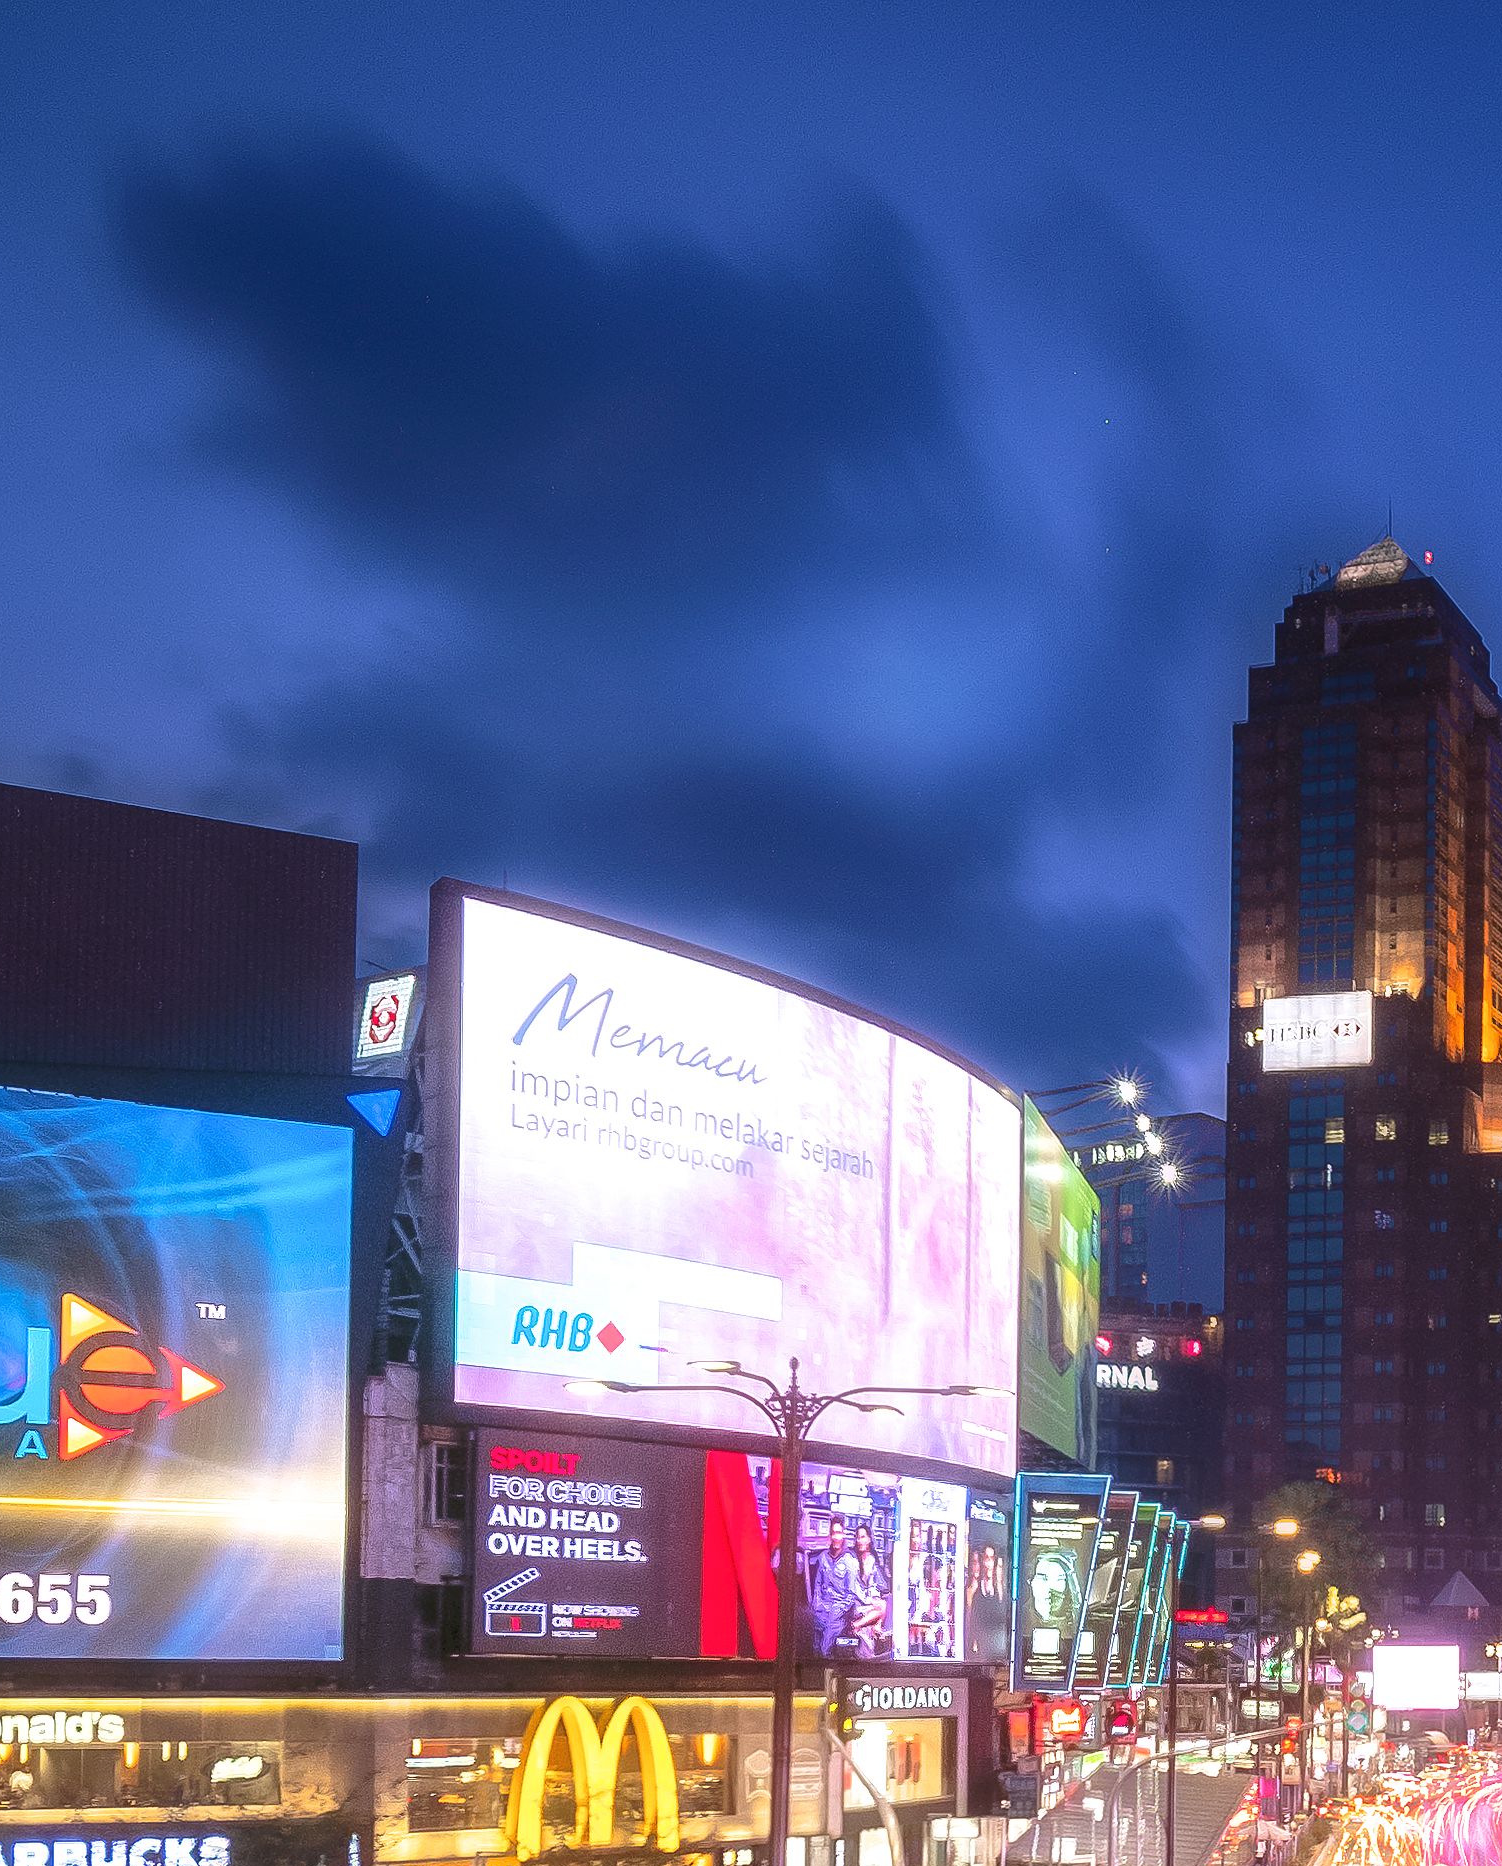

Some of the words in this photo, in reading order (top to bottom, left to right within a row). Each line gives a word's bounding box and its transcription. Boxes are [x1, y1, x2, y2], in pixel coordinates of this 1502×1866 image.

[511, 972, 768, 1085] Memacu
[511, 1060, 620, 1114] impian
[630, 1089, 684, 1127] dan
[694, 1112, 795, 1156] melakar
[800, 1137, 875, 1181] sejarah
[511, 1103, 589, 1141] Layari
[597, 1125, 756, 1180] rhbgroup.com
[511, 1305, 594, 1353] RHB
[489, 1446, 581, 1476] SPOILT
[488, 1473, 546, 1503] FOR
[547, 1480, 644, 1509] CHOICE
[488, 1504, 547, 1530] AND
[549, 1508, 621, 1534] HEAD
[487, 1532, 560, 1559] OVER
[561, 1537, 649, 1564] HEELS.
[855, 1683, 953, 1713] GIORDANO
